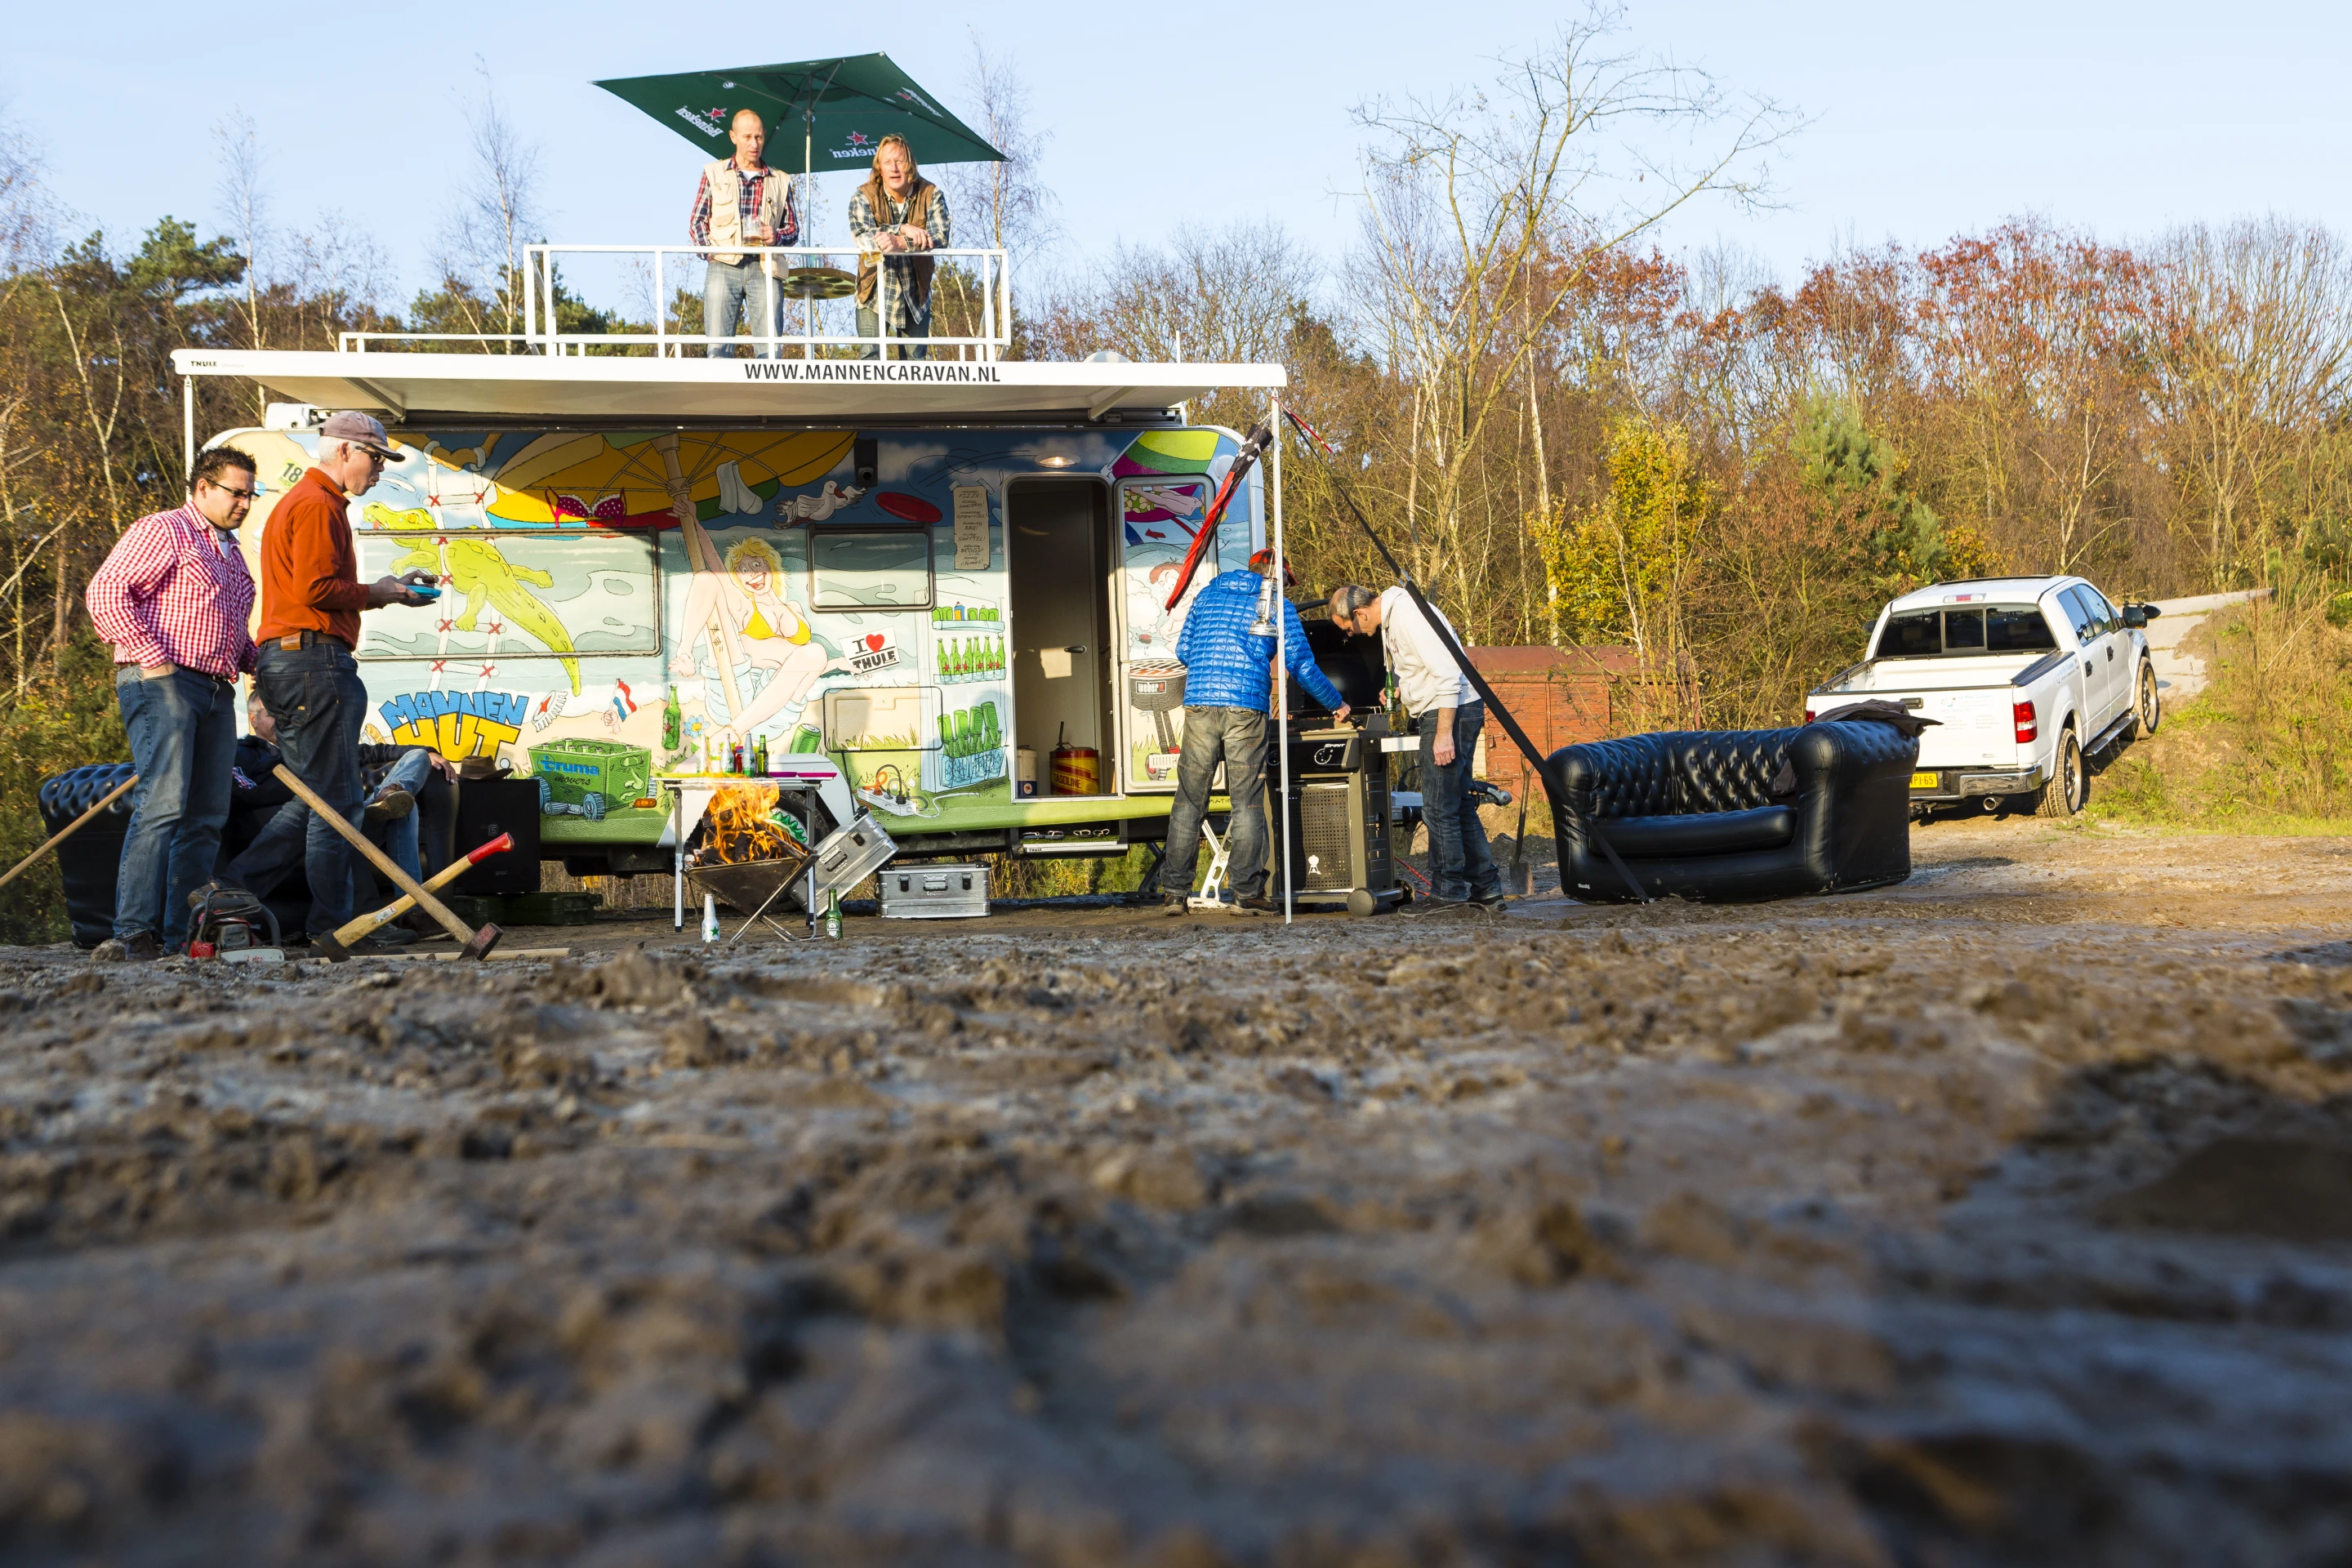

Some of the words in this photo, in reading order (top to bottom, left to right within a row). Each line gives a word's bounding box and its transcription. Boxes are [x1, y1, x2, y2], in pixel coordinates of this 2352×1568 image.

[744, 363, 1000, 382] WWW.MANNENCARAVAN.NL
[283, 462, 303, 483] 18
[852, 638, 867, 654] I
[852, 650, 897, 670] THULE
[378, 690, 530, 730] MANNEN
[539, 755, 599, 776] truma
